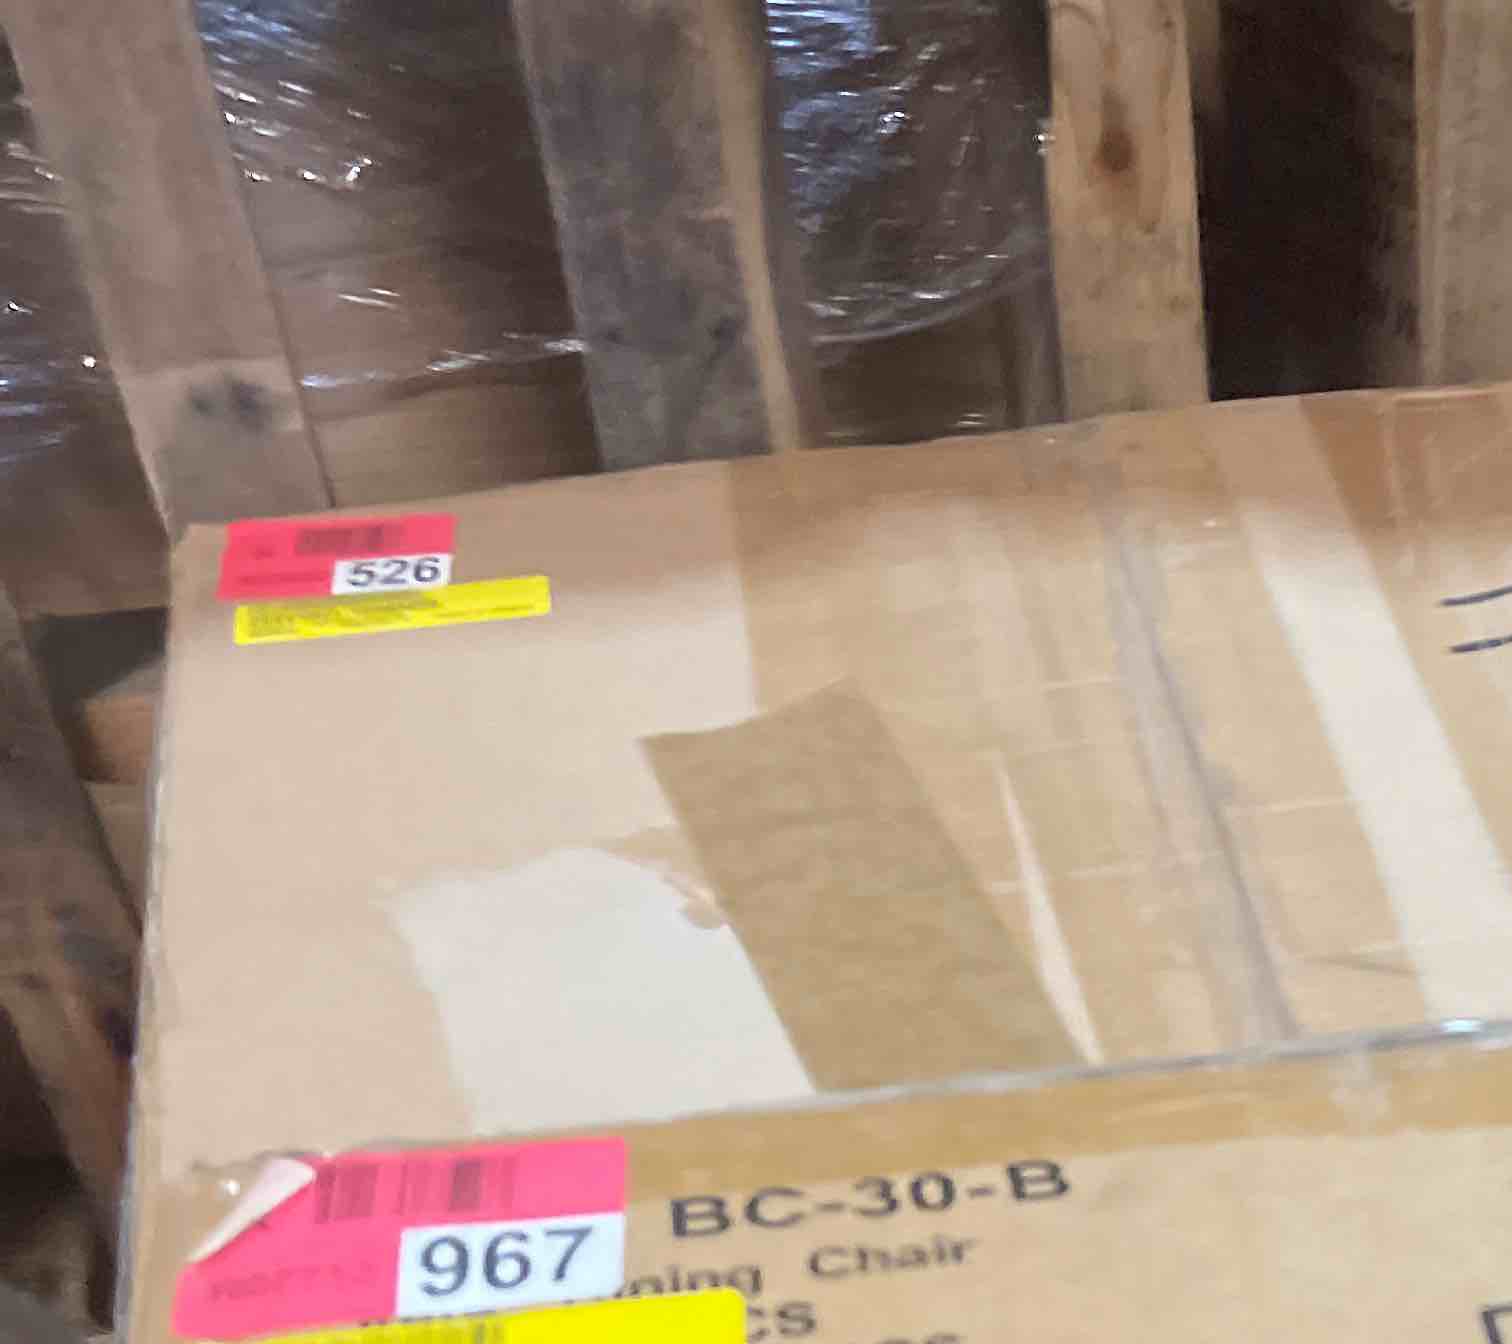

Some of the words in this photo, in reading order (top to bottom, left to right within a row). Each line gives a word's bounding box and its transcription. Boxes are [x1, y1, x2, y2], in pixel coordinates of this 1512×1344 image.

[346, 556, 441, 589] 526
[669, 1158, 1071, 1239] BC-30-B
[419, 1226, 595, 1297] 967
[806, 1233, 976, 1280] Chair
